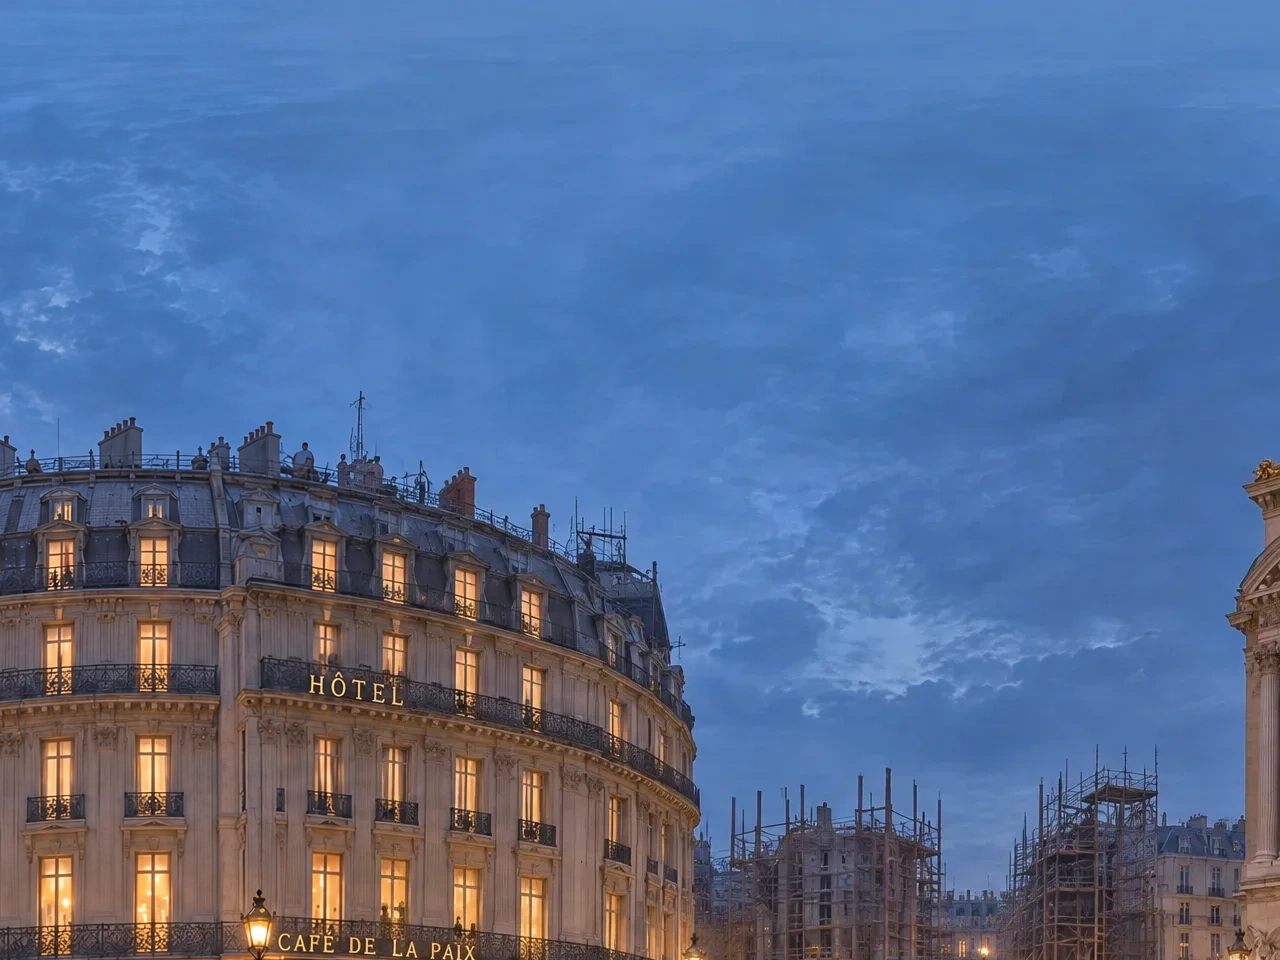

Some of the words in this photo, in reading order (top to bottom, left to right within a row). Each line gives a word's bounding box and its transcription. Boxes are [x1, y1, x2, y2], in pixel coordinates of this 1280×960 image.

[309, 671, 404, 706] HÔTEL
[349, 936, 376, 955] DE
[392, 939, 418, 958] LA
